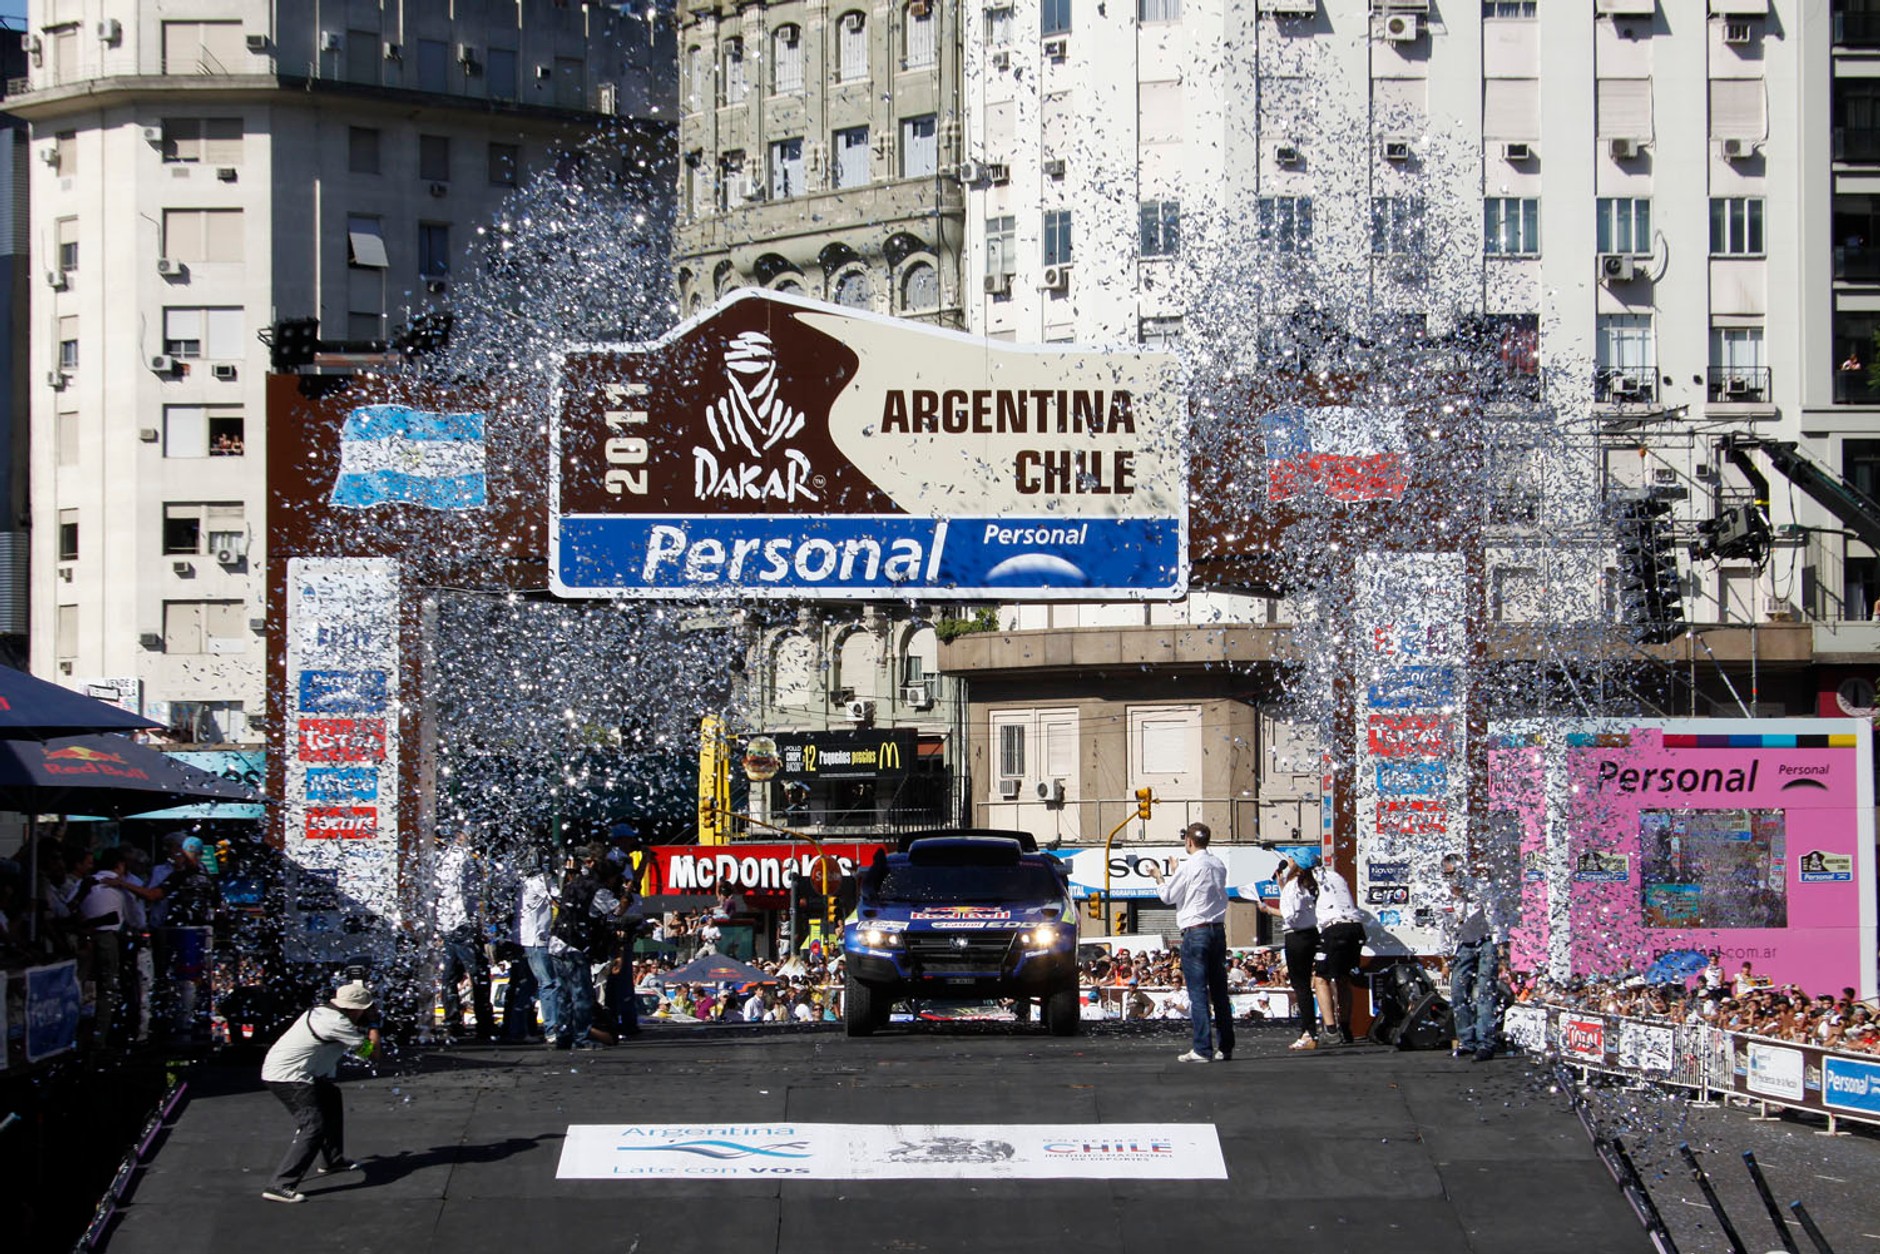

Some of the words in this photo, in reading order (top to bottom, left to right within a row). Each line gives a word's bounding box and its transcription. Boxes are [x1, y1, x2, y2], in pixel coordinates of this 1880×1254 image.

[881, 390, 1135, 433] ARGENTINA
[605, 384, 648, 494] 2011
[692, 446, 819, 503] DAKAR
[1015, 450, 1134, 494] CHILE
[984, 524, 1087, 546] Personal
[642, 522, 948, 582] Personal
[43, 763, 98, 774] Red
[101, 764, 149, 780] Bull
[804, 745, 816, 772] 12
[1779, 763, 1830, 775] Personal
[1600, 759, 1759, 793] Personal
[911, 911, 960, 919] Red
[962, 910, 1010, 919] Bull
[1827, 1069, 1868, 1095] Personal
[621, 1127, 795, 1137] Argentina
[1043, 1143, 1172, 1153] CHILE
[613, 1166, 676, 1174] Late
